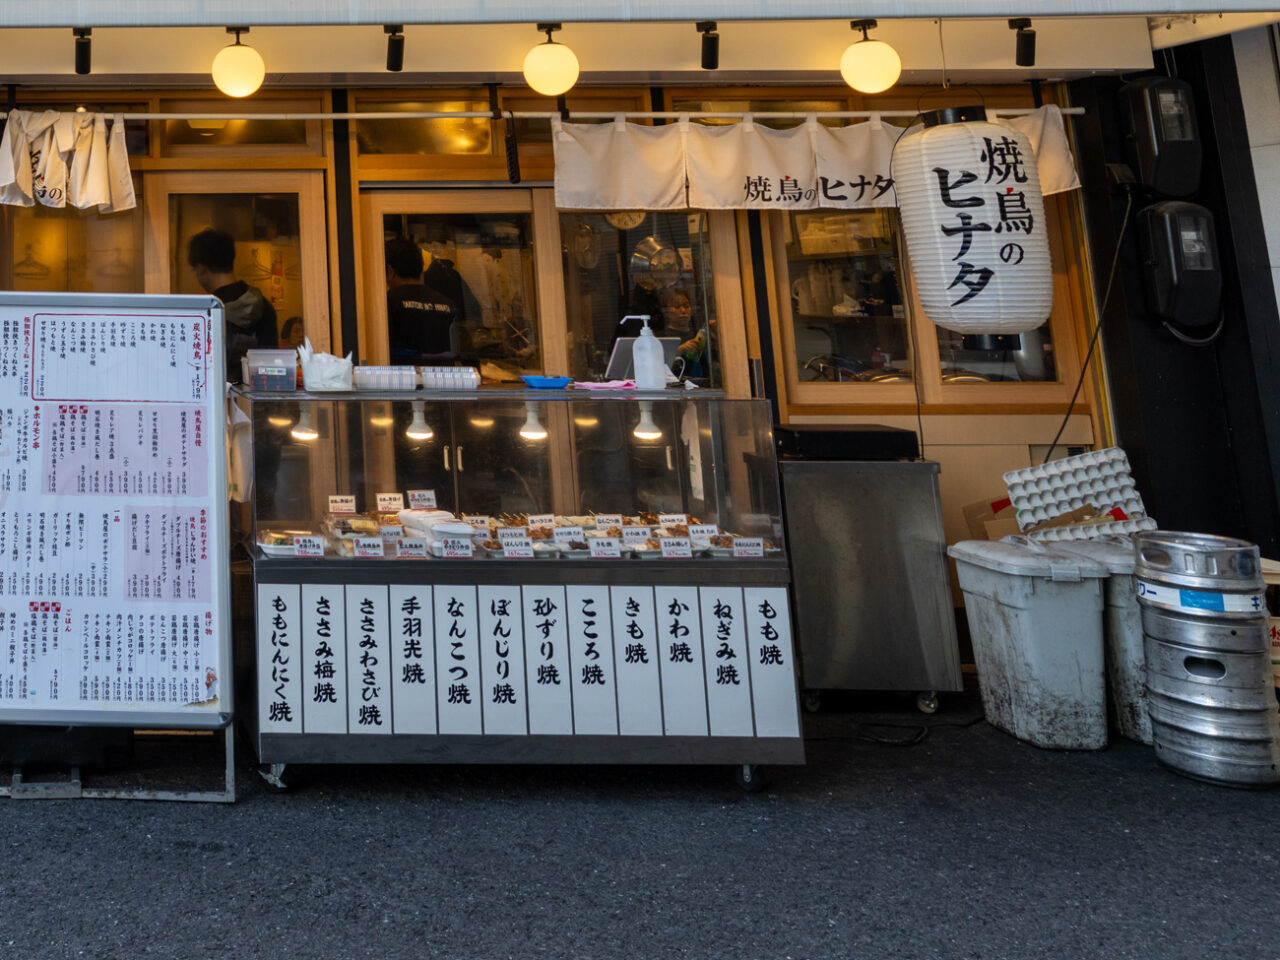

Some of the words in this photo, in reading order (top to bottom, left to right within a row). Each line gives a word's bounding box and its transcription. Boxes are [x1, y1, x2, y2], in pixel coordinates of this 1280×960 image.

[743, 174, 896, 204] 焼鳥のヒナタ
[980, 135, 1034, 266] 焼鳥の
[931, 167, 996, 308] ヒナタ
[193, 322, 201, 360] 炭火焼鳥
[268, 596, 294, 723] ももにんにく焼
[312, 596, 338, 705] ささみ梅焼
[358, 598, 384, 728] ささみわさび焼
[401, 597, 427, 685] 手羽先焼
[446, 597, 473, 706] なんこつ焼
[490, 598, 518, 706] ぼんじり焼
[532, 598, 562, 686] 砂ずり焼
[580, 600, 607, 687] こころ焼
[624, 597, 650, 665] きも焼
[668, 598, 694, 665] かわ焼
[713, 598, 741, 686] ねぎみ焼
[757, 599, 784, 667] もも焼
